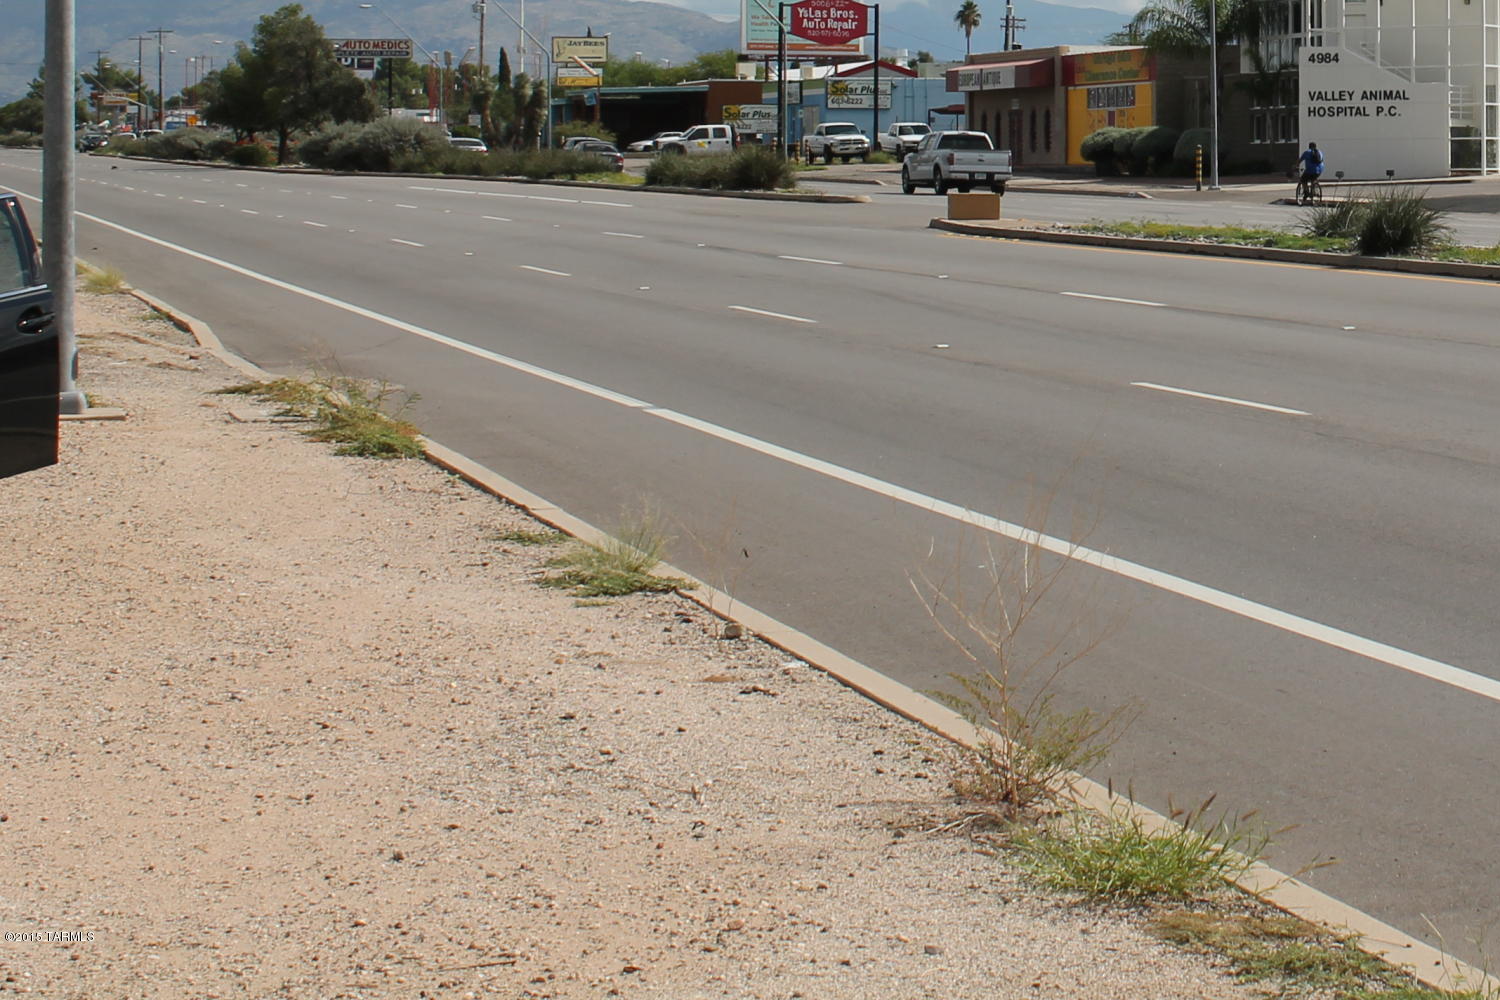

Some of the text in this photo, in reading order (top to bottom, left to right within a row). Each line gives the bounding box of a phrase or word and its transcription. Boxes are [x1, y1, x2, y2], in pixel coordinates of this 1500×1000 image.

[342, 40, 410, 50] AUTO MEDICS
[1308, 53, 1339, 63] 4984
[831, 81, 859, 95] Solar
[860, 85, 880, 94] Plu
[1308, 90, 1411, 101] VALLEY ANIMAL
[724, 106, 771, 119] Solar Plus
[1307, 106, 1402, 117] HOSPITAL P.C.
